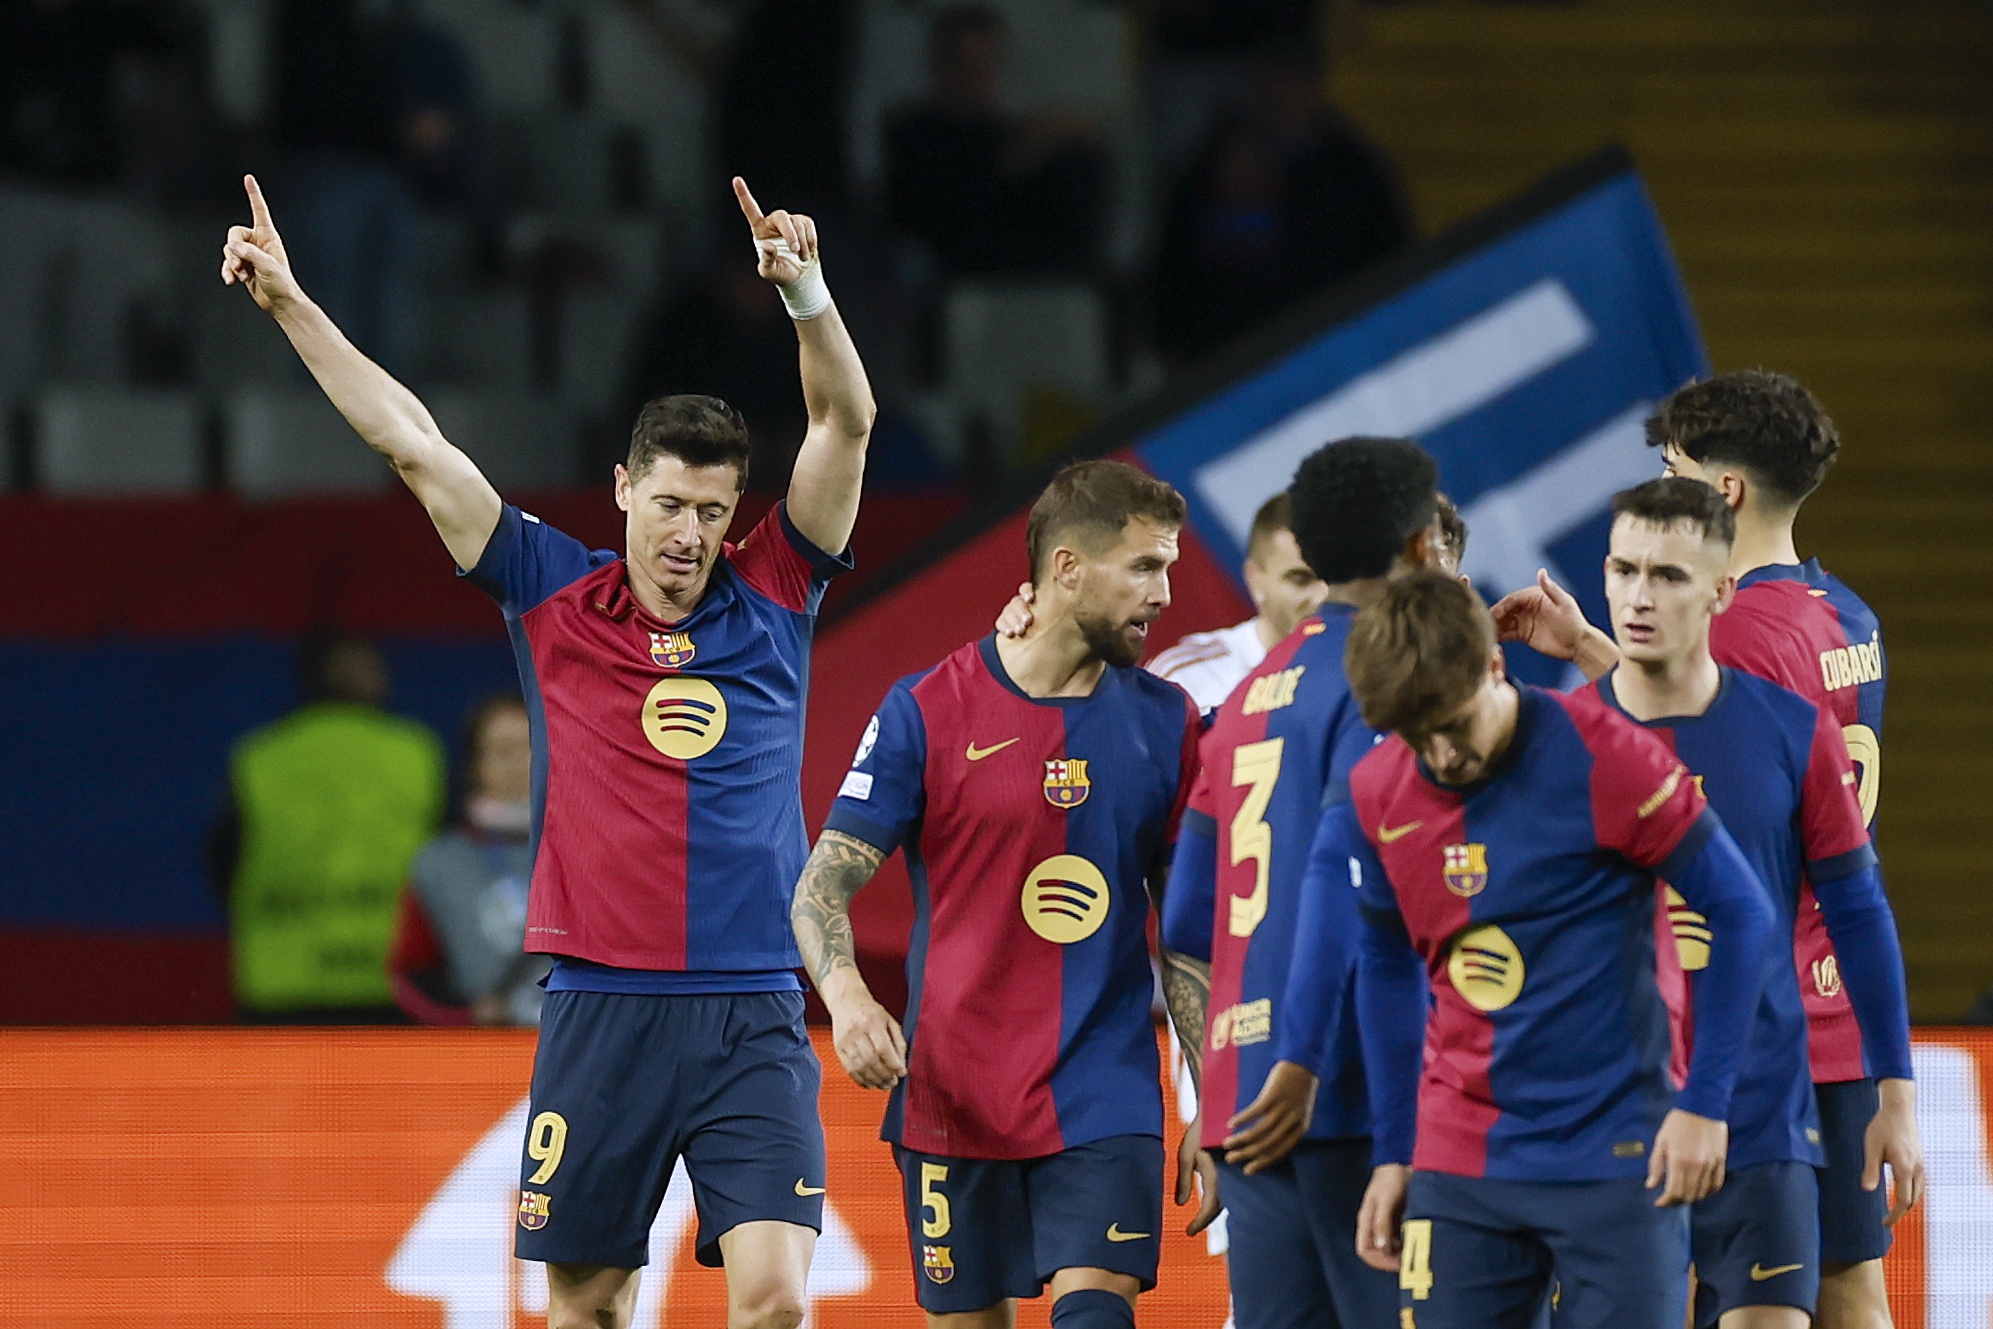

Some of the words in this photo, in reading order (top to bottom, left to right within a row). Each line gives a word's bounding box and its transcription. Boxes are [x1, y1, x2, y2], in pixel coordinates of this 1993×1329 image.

[1229, 737, 1285, 938] 3
[528, 1111, 568, 1185] 9
[922, 1162, 951, 1238] 5
